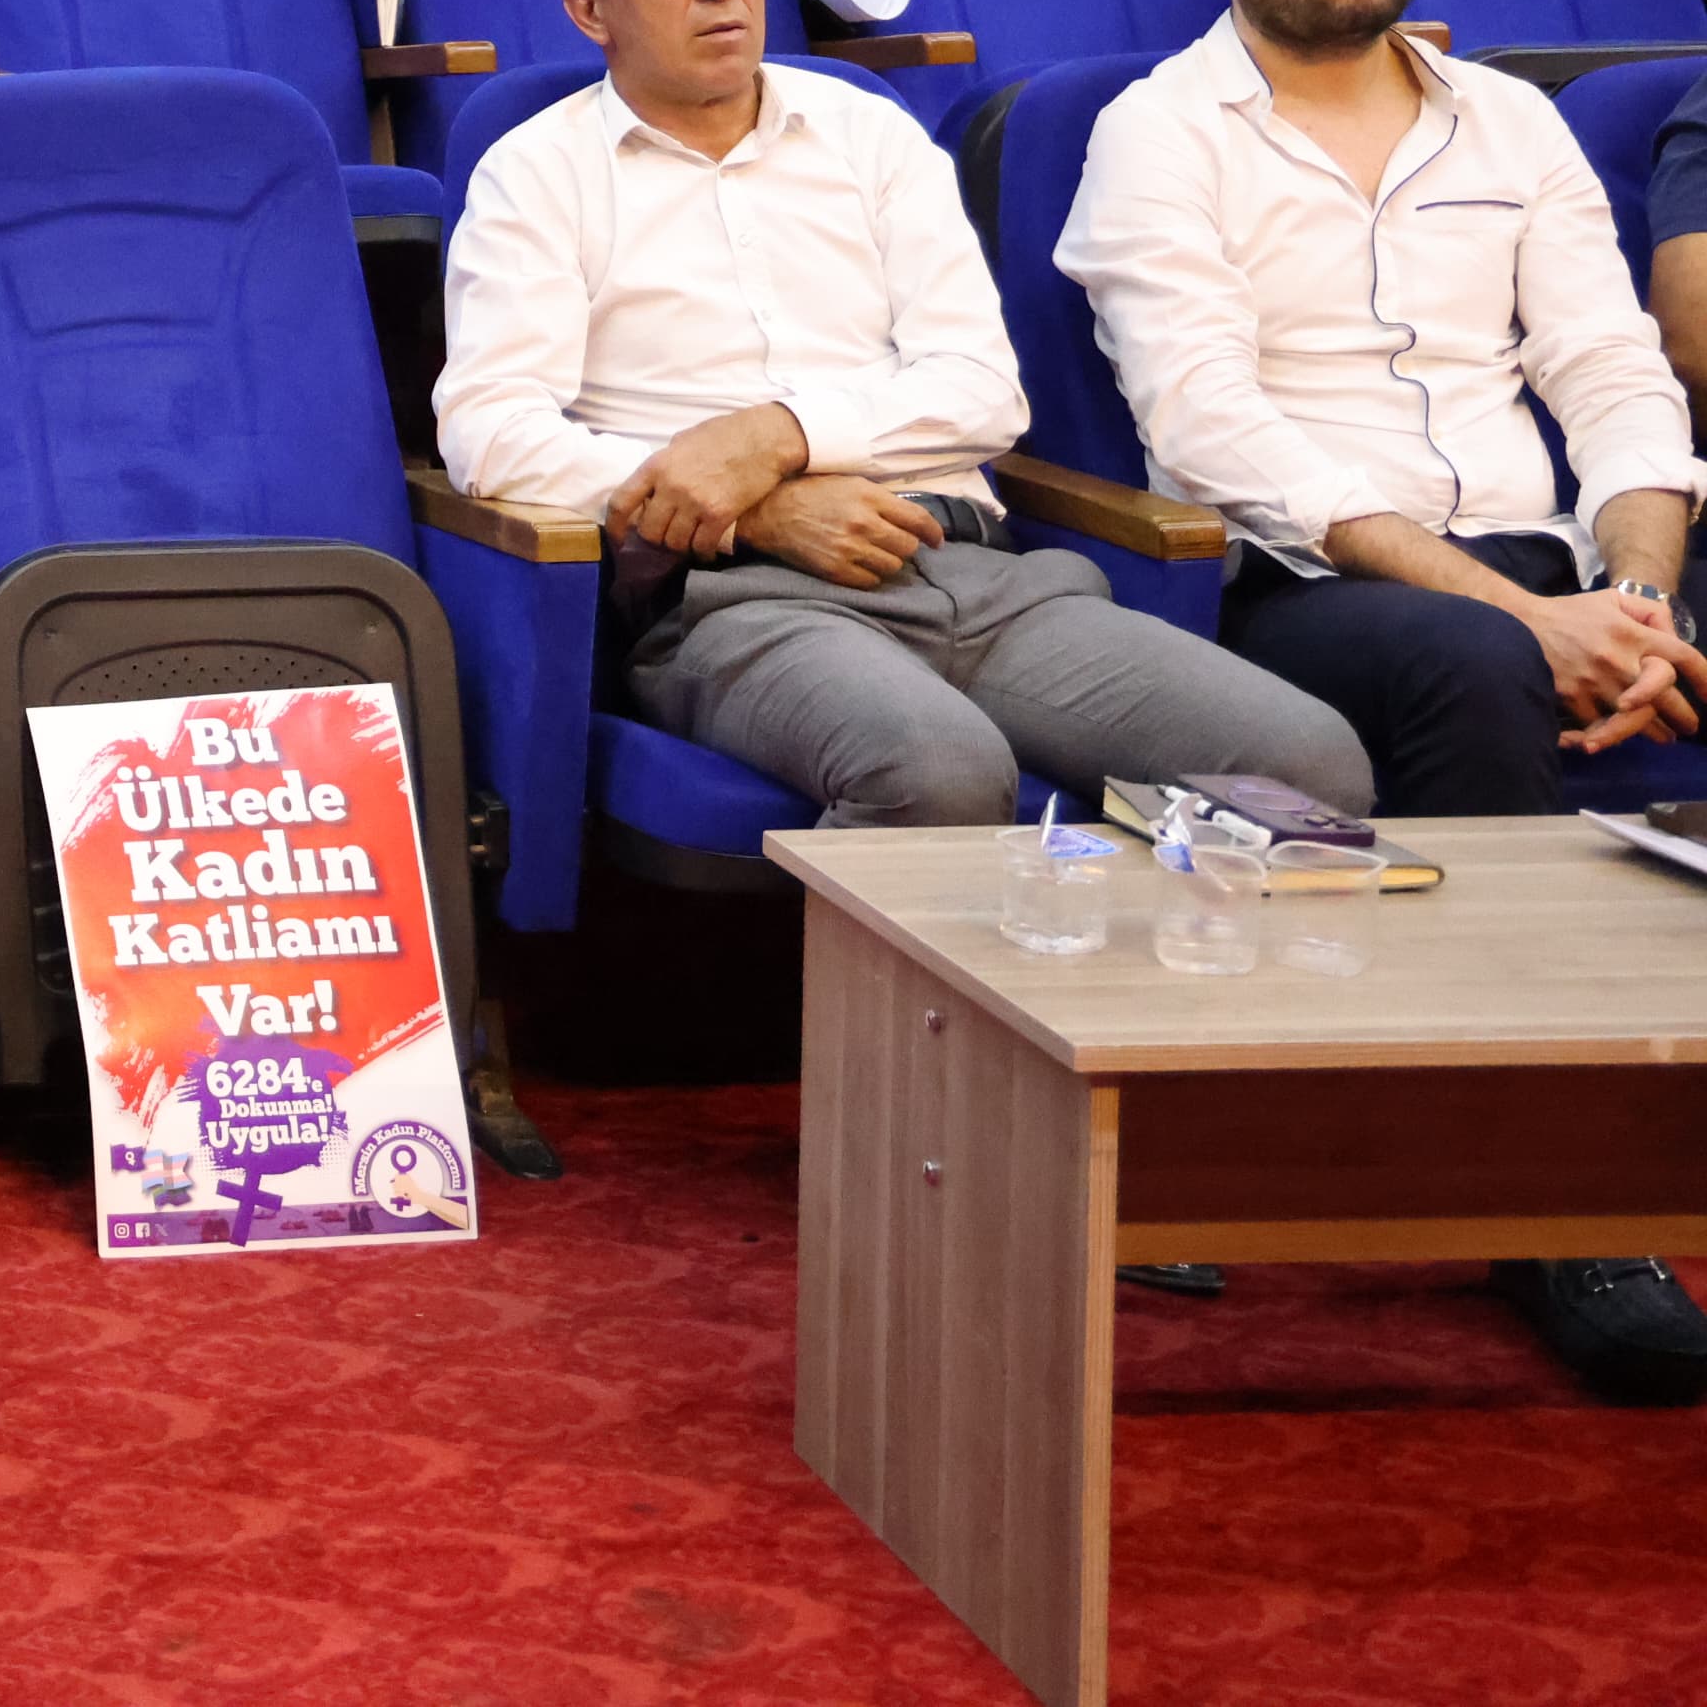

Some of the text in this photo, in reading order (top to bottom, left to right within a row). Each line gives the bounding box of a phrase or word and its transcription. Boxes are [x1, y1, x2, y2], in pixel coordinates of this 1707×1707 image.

[183, 717, 279, 766] Bu
[111, 765, 348, 832] Ülkede
[123, 829, 377, 902] Kadın
[108, 904, 399, 967] Katliamı
[196, 980, 338, 1037] Var!
[206, 1057, 324, 1098] 6284'e
[219, 1093, 333, 1119] Dokunma!
[205, 1115, 329, 1156] Uygula!
[354, 1124, 462, 1195] Mersin Kadın Platformu
